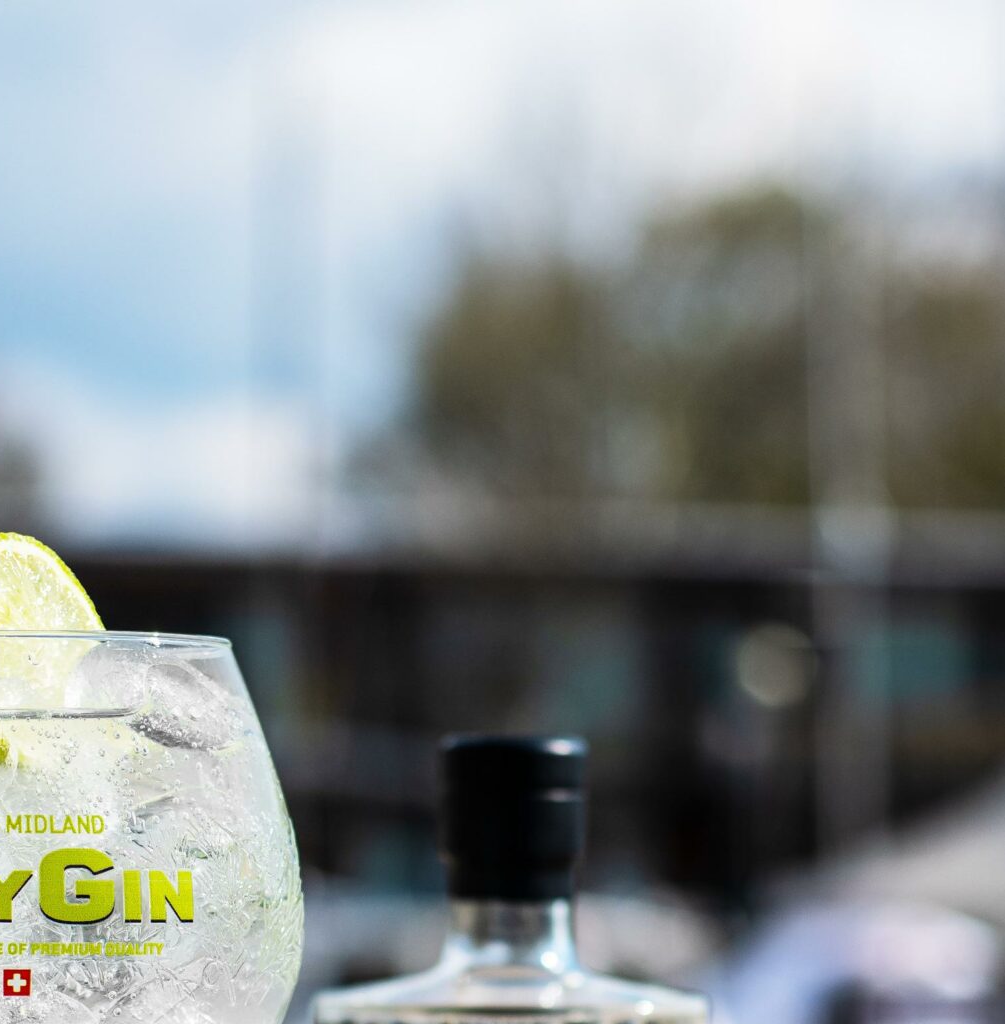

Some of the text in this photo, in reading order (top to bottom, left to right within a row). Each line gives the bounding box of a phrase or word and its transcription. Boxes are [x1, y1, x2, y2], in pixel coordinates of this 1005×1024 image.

[5, 813, 105, 835] MIDLAND
[7, 942, 28, 956] OF
[30, 942, 102, 956] PREMIUM
[104, 942, 165, 958] QUALITY
